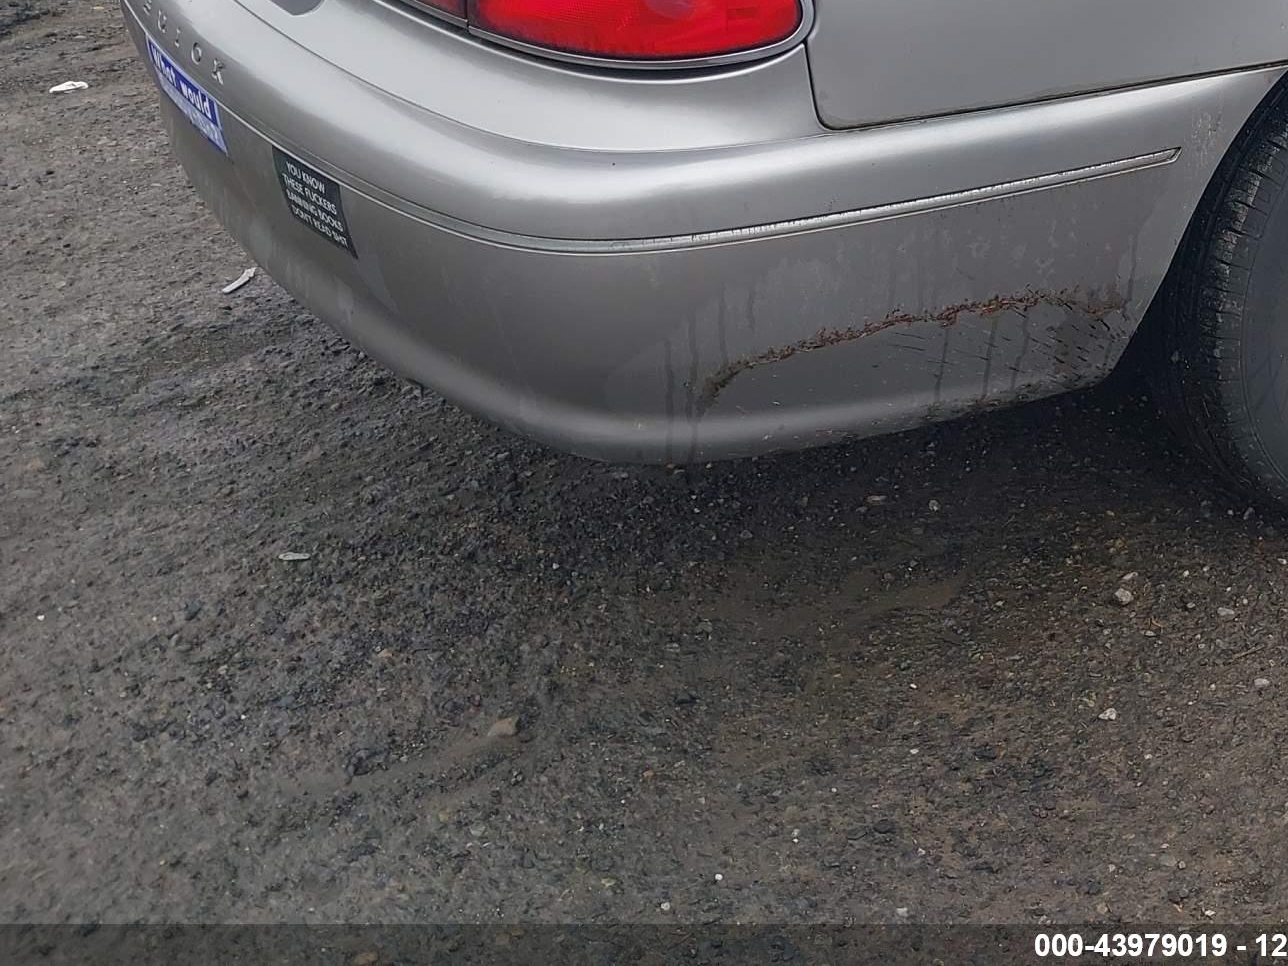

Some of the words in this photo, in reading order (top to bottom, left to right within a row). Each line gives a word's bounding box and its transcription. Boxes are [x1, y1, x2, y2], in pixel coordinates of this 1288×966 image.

[150, 41, 177, 87] What
[180, 80, 212, 119] would
[282, 172, 305, 196] THESE
[304, 187, 337, 215] FUCKERS
[286, 161, 302, 179] YOU
[302, 170, 325, 194] KNOW
[318, 209, 344, 232] BOOKS
